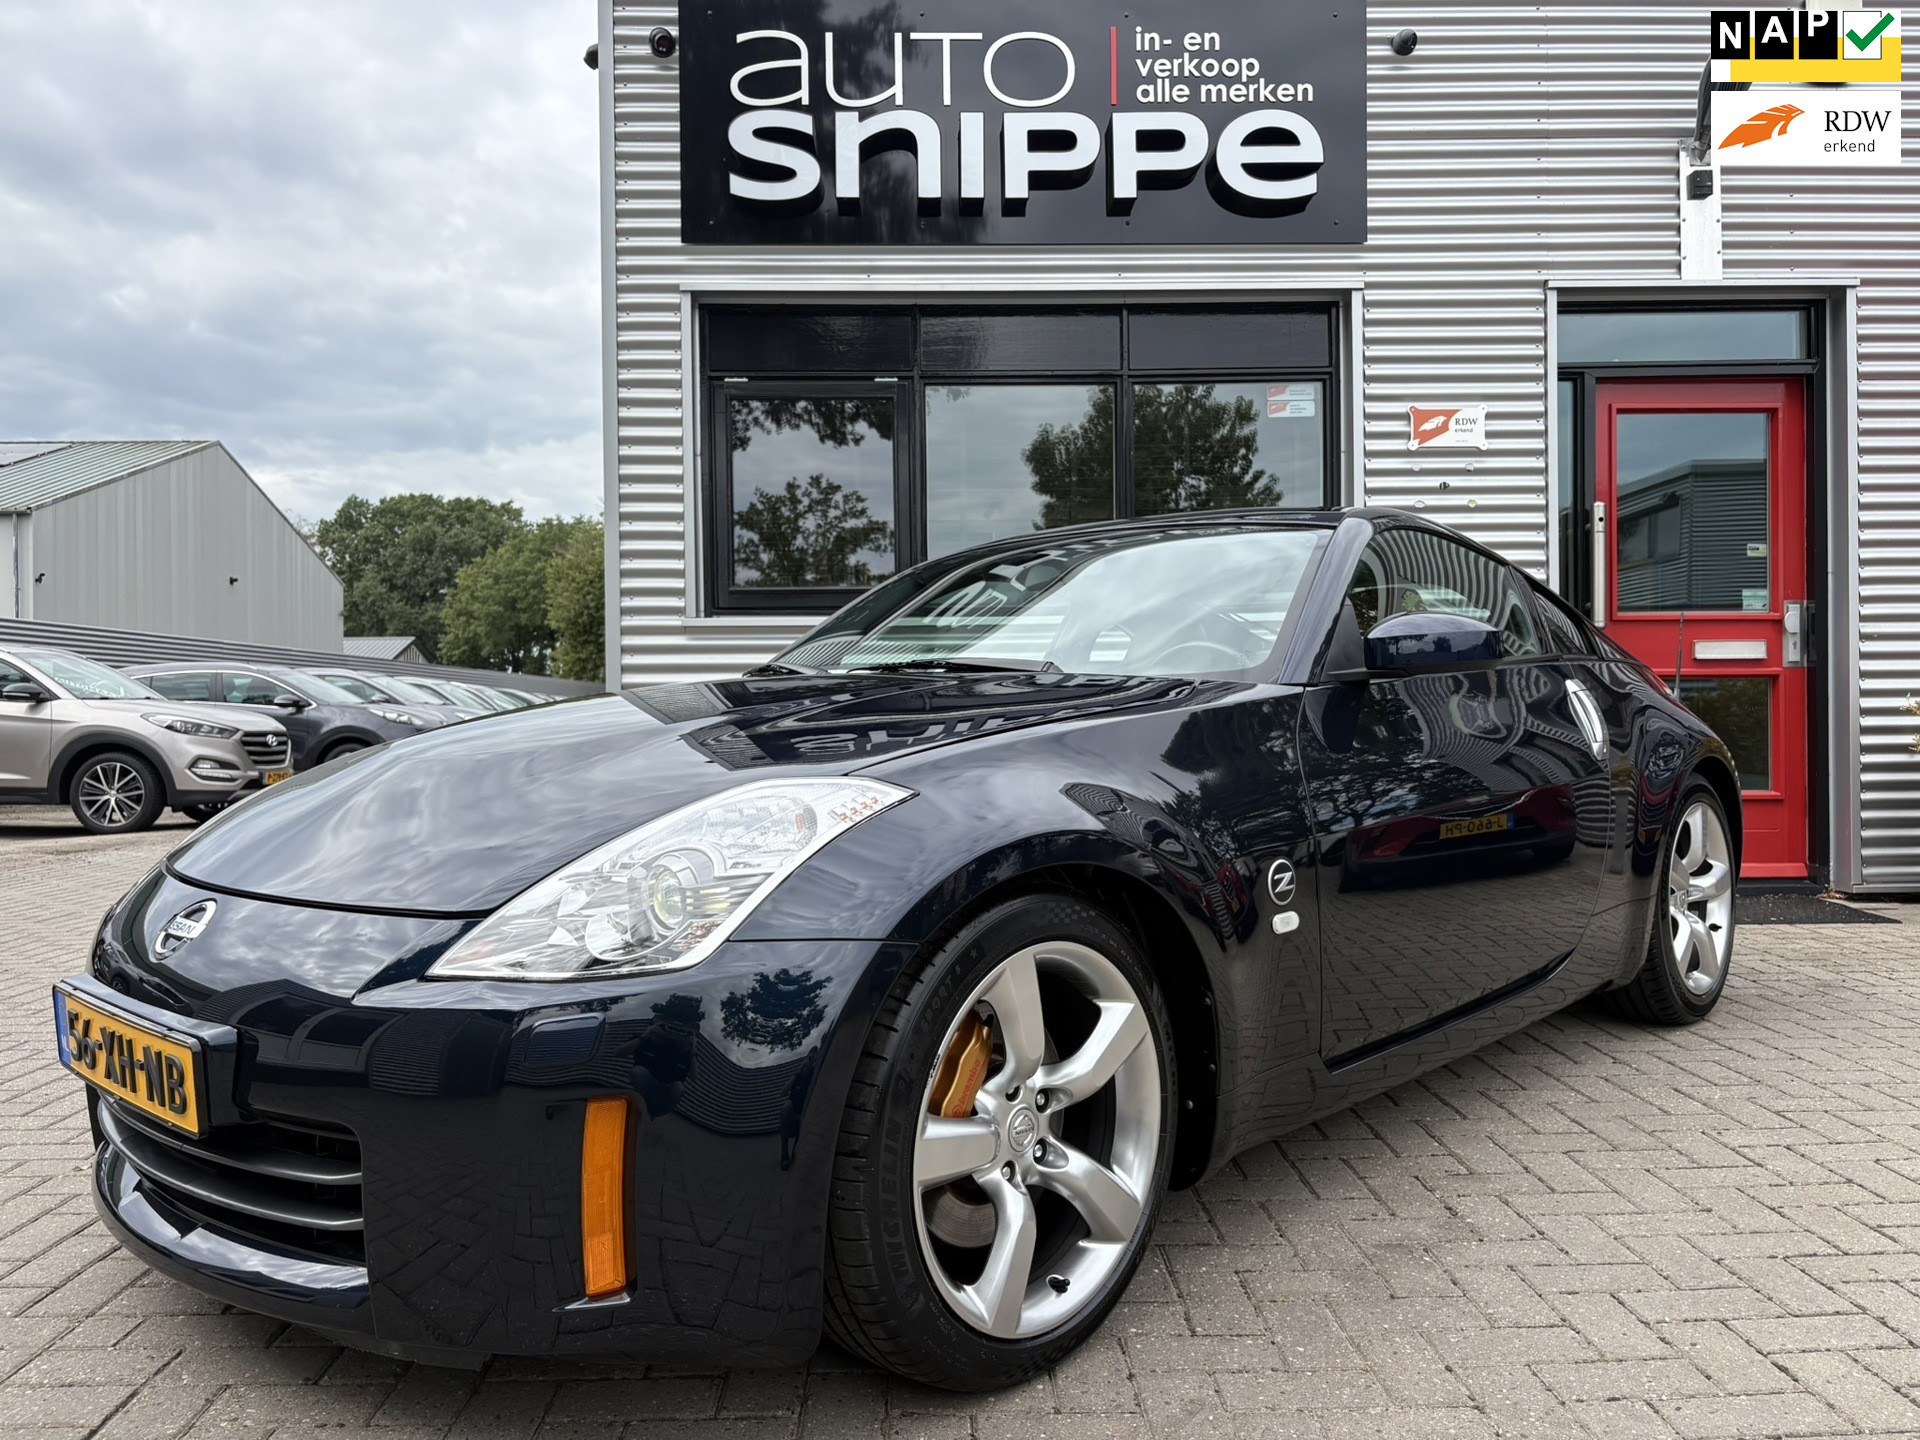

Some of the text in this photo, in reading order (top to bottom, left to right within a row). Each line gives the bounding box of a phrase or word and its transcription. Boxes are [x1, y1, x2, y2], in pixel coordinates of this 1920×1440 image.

[1134, 26, 1221, 52] in- en
[1134, 53, 1261, 80] verkoop
[1135, 79, 1315, 104] alle merken
[1454, 417, 1479, 426] RDW
[67, 1008, 188, 1116] 56-XH-NB
[958, 1059, 981, 1106] brembo
[880, 1117, 910, 1279] MICHELIN
